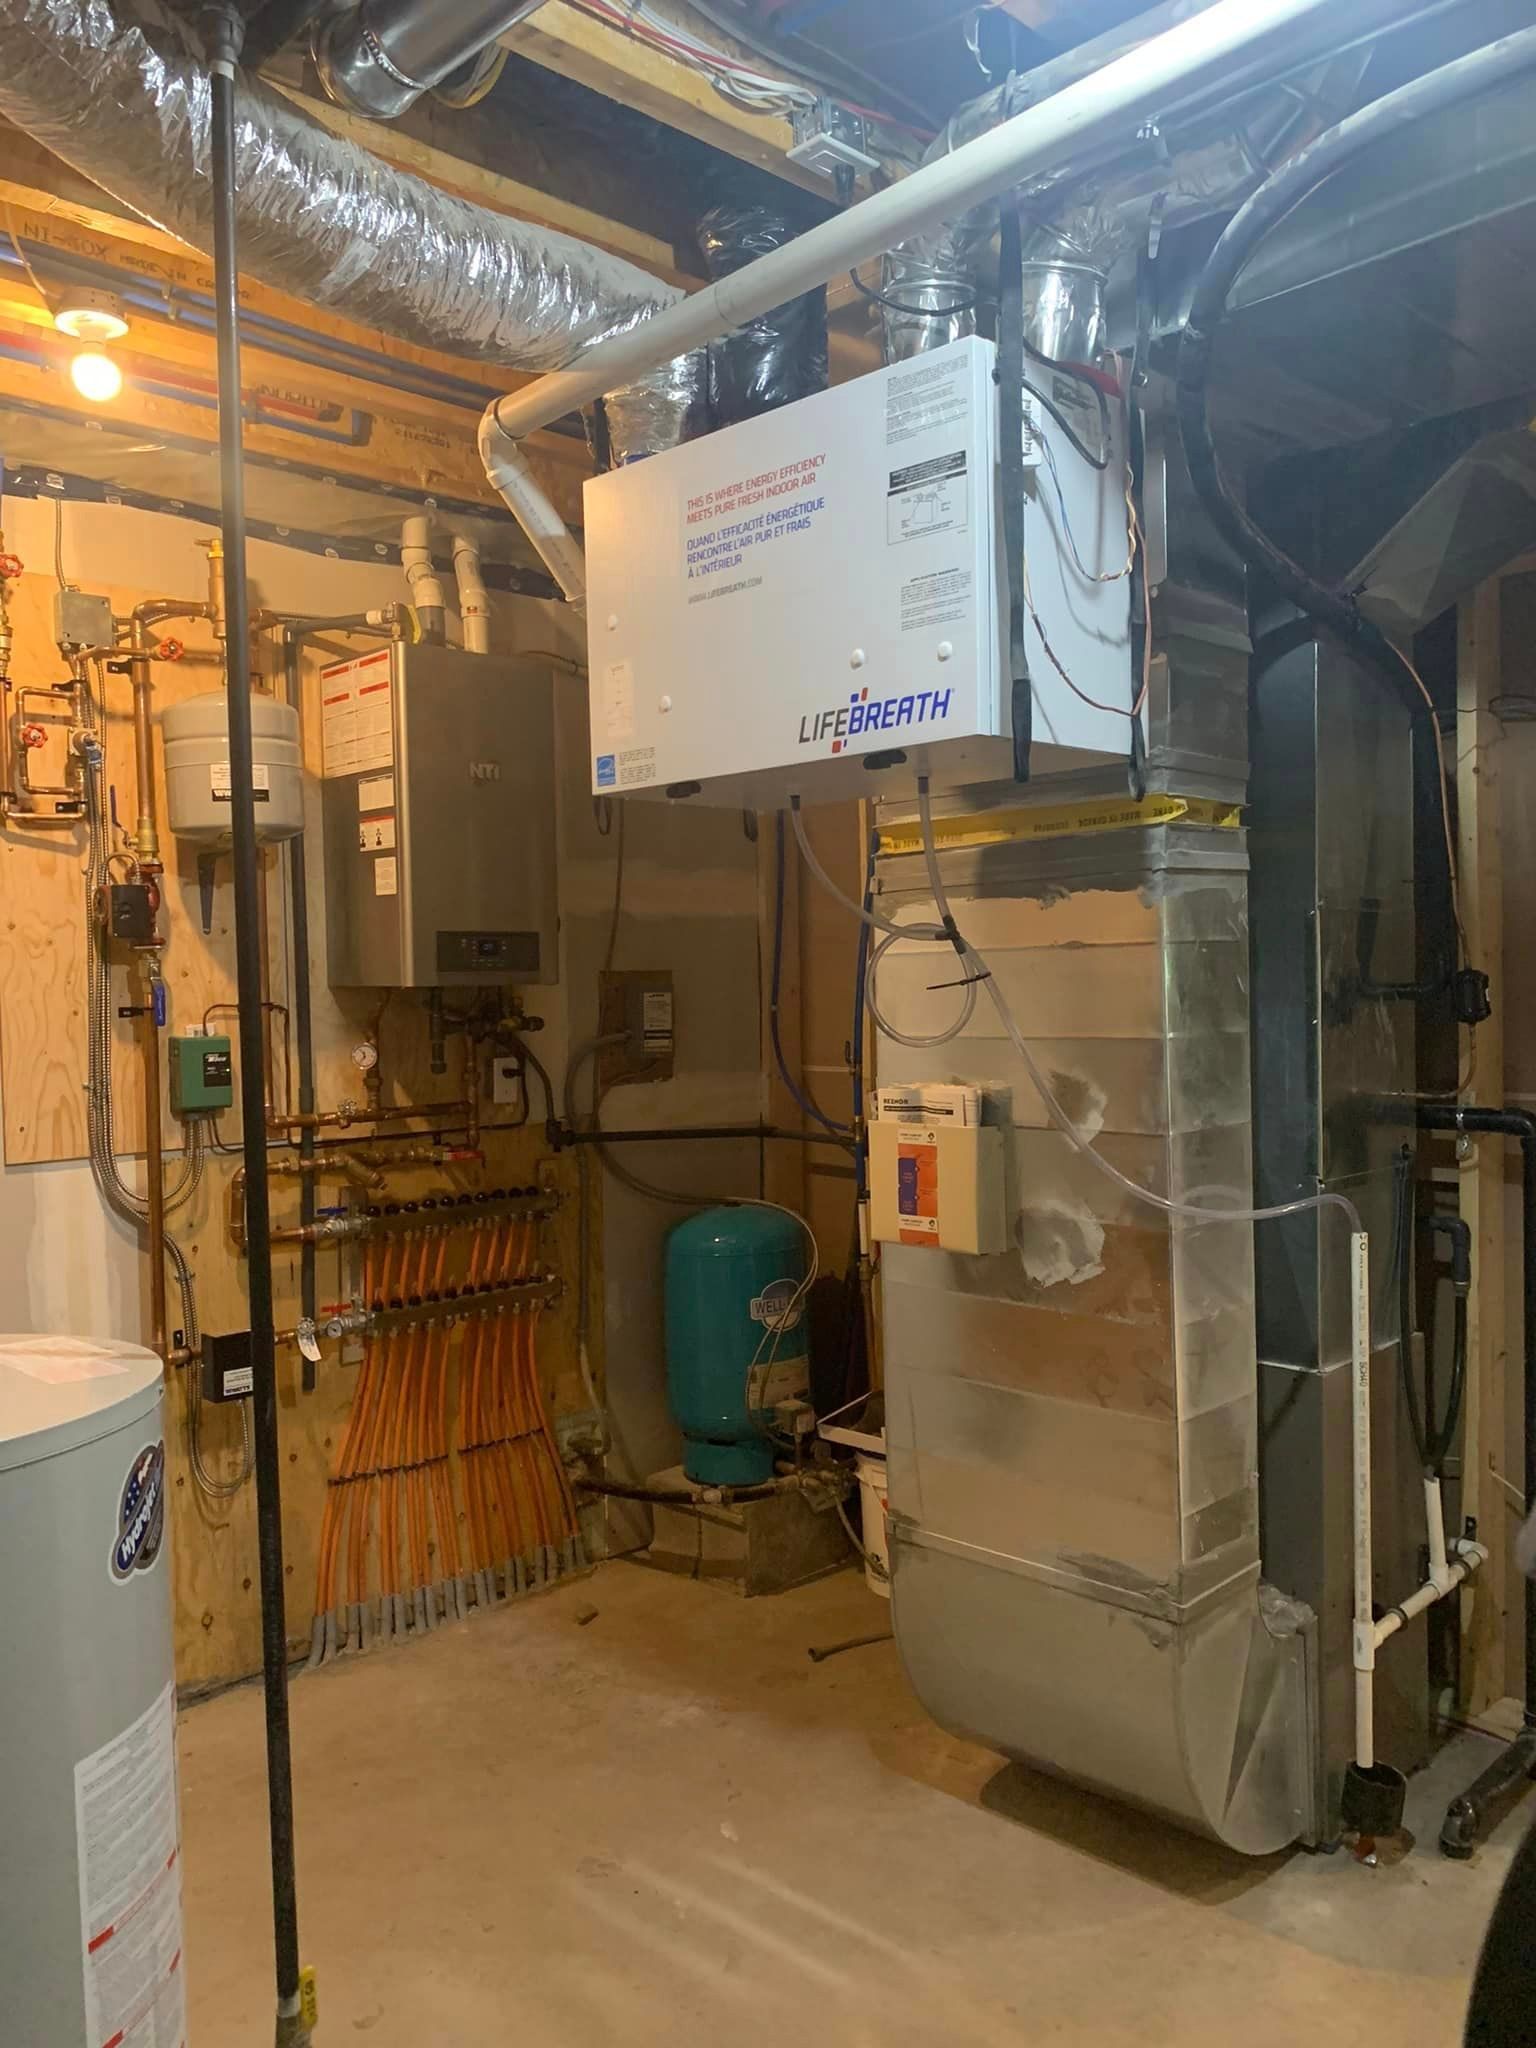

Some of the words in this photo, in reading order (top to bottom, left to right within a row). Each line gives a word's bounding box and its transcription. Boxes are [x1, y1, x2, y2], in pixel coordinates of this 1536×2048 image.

[686, 508, 713, 525] MEETS
[714, 502, 737, 517] PURE
[737, 490, 764, 508] FRESH
[766, 479, 799, 499] INDOOR
[800, 472, 816, 488] AIR
[687, 495, 704, 511] THIS
[705, 492, 714, 505] IS
[714, 482, 744, 503] WHERE
[745, 470, 779, 492] ENERGY
[780, 453, 826, 479] EFFICIENCY
[687, 532, 716, 551] QUAND
[716, 514, 765, 541] L'EFFICACITÉ
[766, 497, 825, 527] ÉNERGÉTIQUE
[687, 542, 734, 565] RENCONTRE
[734, 535, 754, 551] L'AIR
[754, 529, 772, 545] PUR
[773, 525, 785, 538] ET
[786, 516, 811, 534] FRAIS
[687, 565, 695, 580] À
[696, 553, 743, 577] L'INTÉRIEUR
[798, 688, 951, 744] LIFEBREATH
[121, 1481, 156, 1562] Hydrojet
